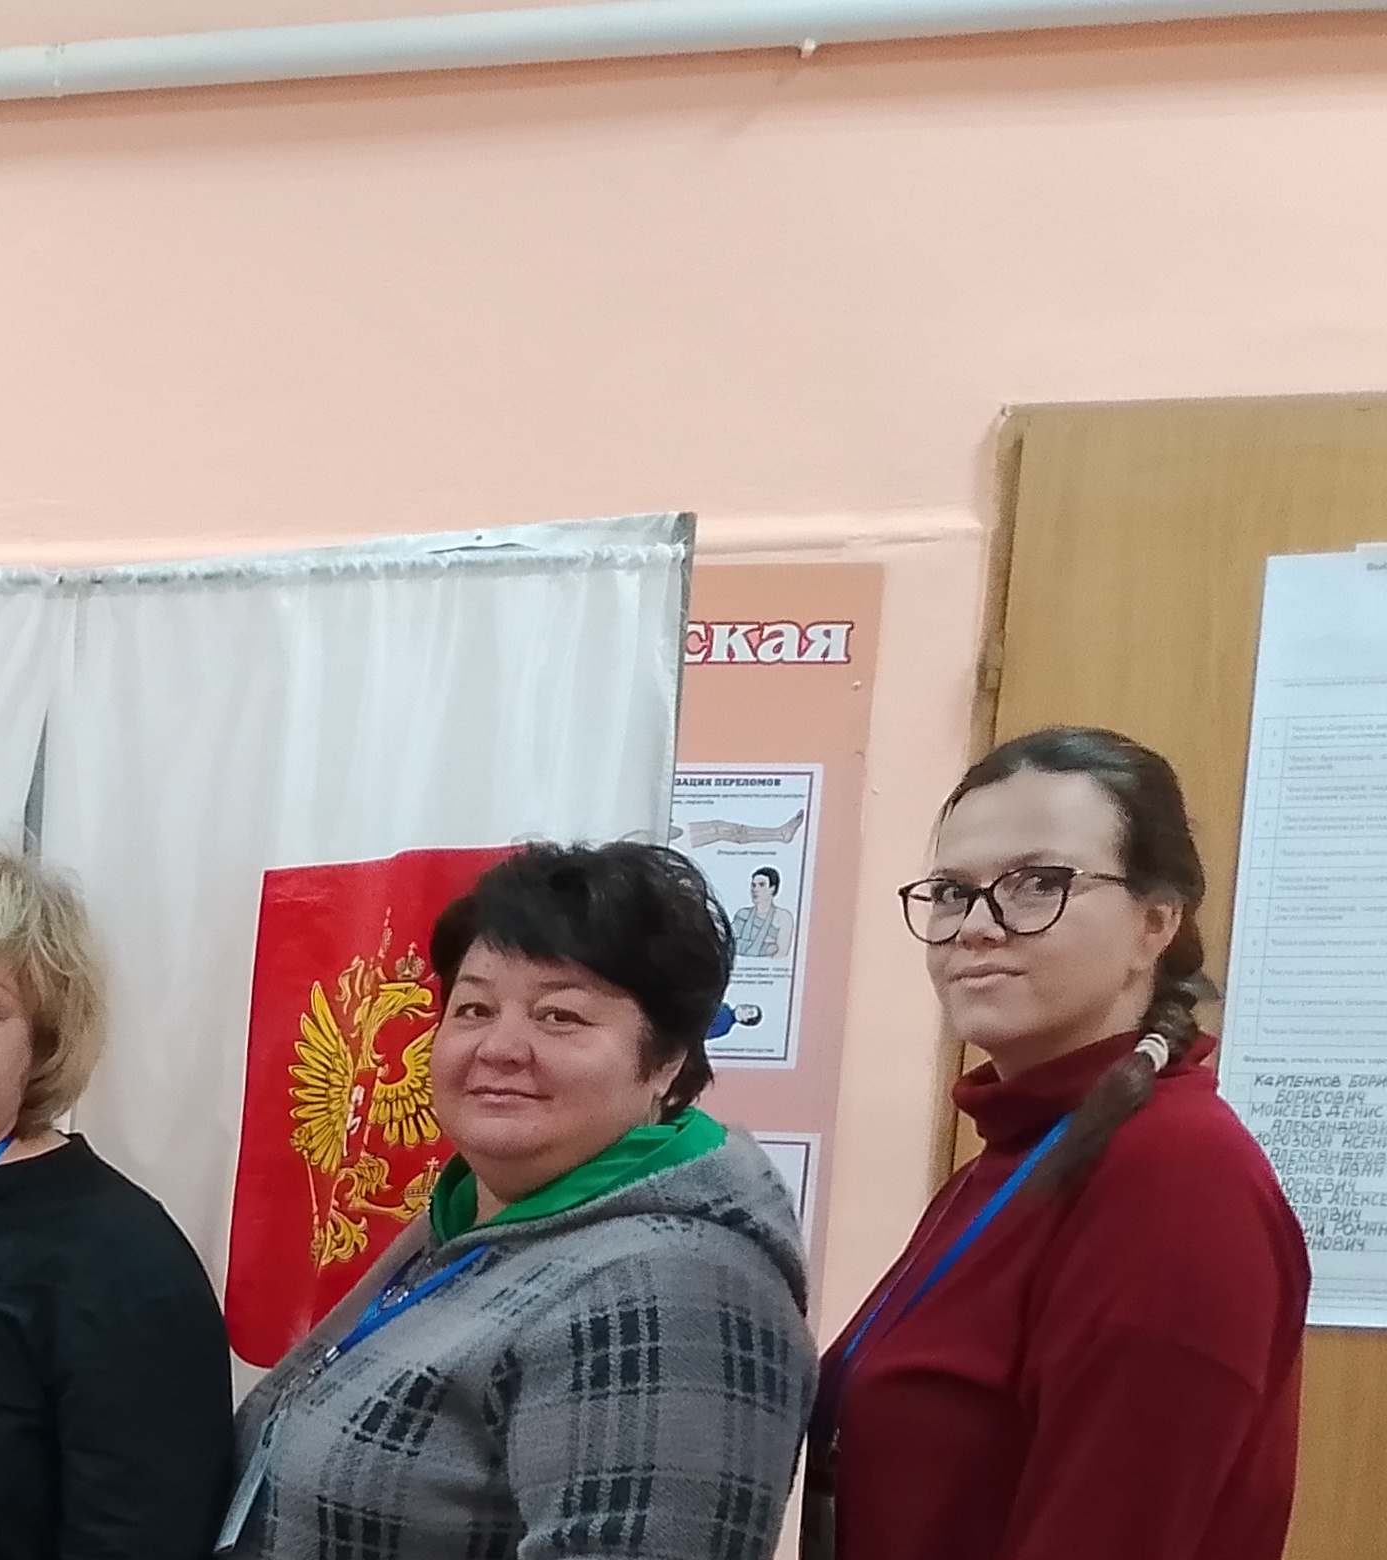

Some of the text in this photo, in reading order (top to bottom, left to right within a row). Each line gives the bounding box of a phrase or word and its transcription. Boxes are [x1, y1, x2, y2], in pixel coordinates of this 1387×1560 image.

[684, 621, 854, 665] ская
[714, 778, 781, 787] ПЕРЕЛОМОВ
[1275, 1089, 1367, 1105] БОРИСОВИЧ
[1251, 1104, 1383, 1119] МОИСЕЕВ ДЕНИС
[1339, 1162, 1384, 1177] ИВАН
